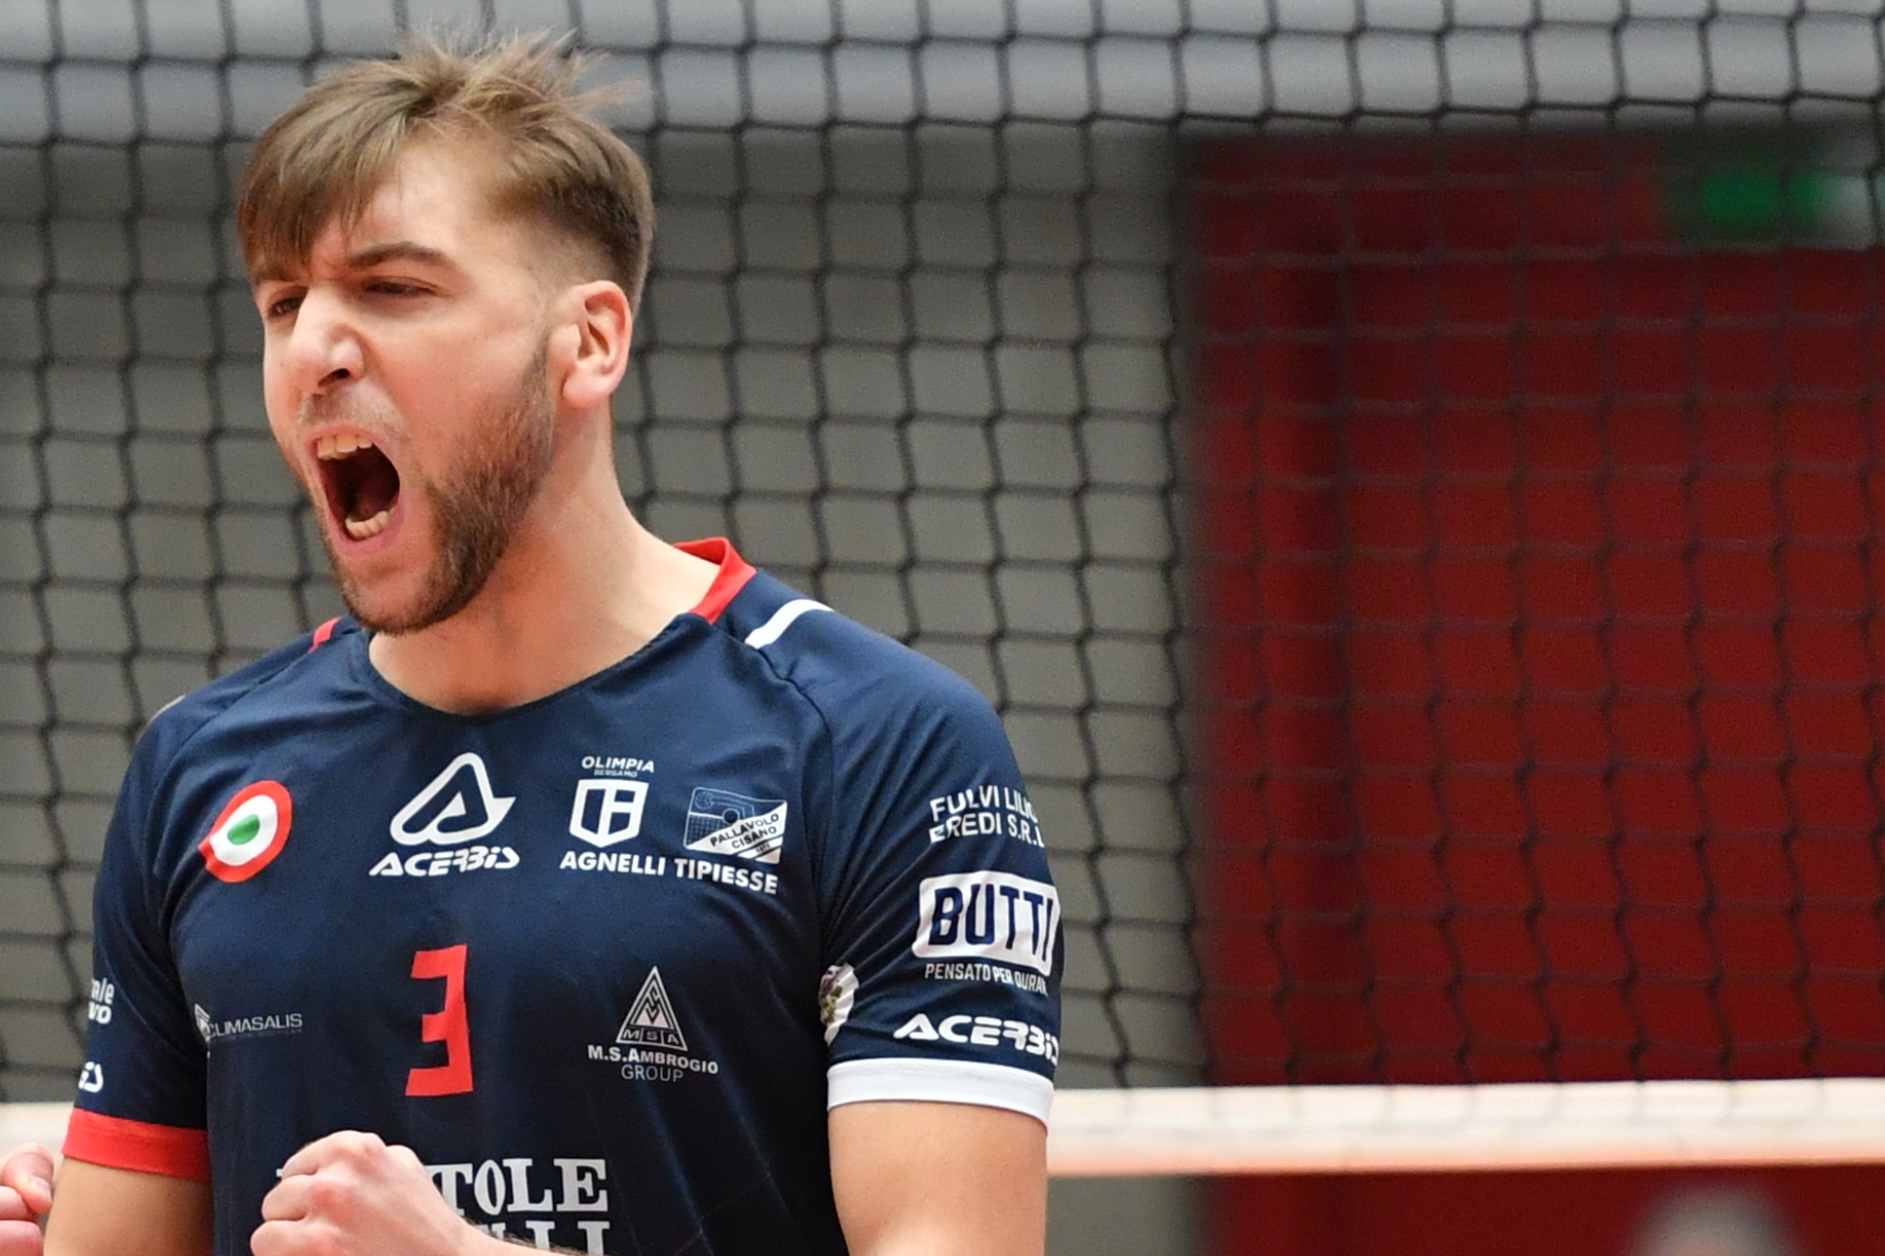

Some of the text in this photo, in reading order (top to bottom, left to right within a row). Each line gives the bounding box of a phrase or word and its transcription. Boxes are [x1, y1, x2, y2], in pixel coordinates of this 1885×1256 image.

[581, 756, 655, 773] OLIMPIA
[929, 784, 1000, 822] FULVI
[709, 813, 780, 847] PALLAVOLO
[731, 826, 777, 849] CISANO
[929, 811, 1002, 844] EREDI
[368, 845, 520, 877] ACERBIS
[559, 850, 780, 895] AGNELLI TIPIESSE
[927, 882, 1055, 965] BUTTI
[924, 963, 991, 982] PENSATO
[207, 1012, 303, 1040] CLIMASALIS
[405, 944, 474, 1097] 3
[893, 1013, 1060, 1067] ACERBIS
[587, 1044, 719, 1075] M.S.AMBROGIO
[621, 1063, 684, 1082] GROUP
